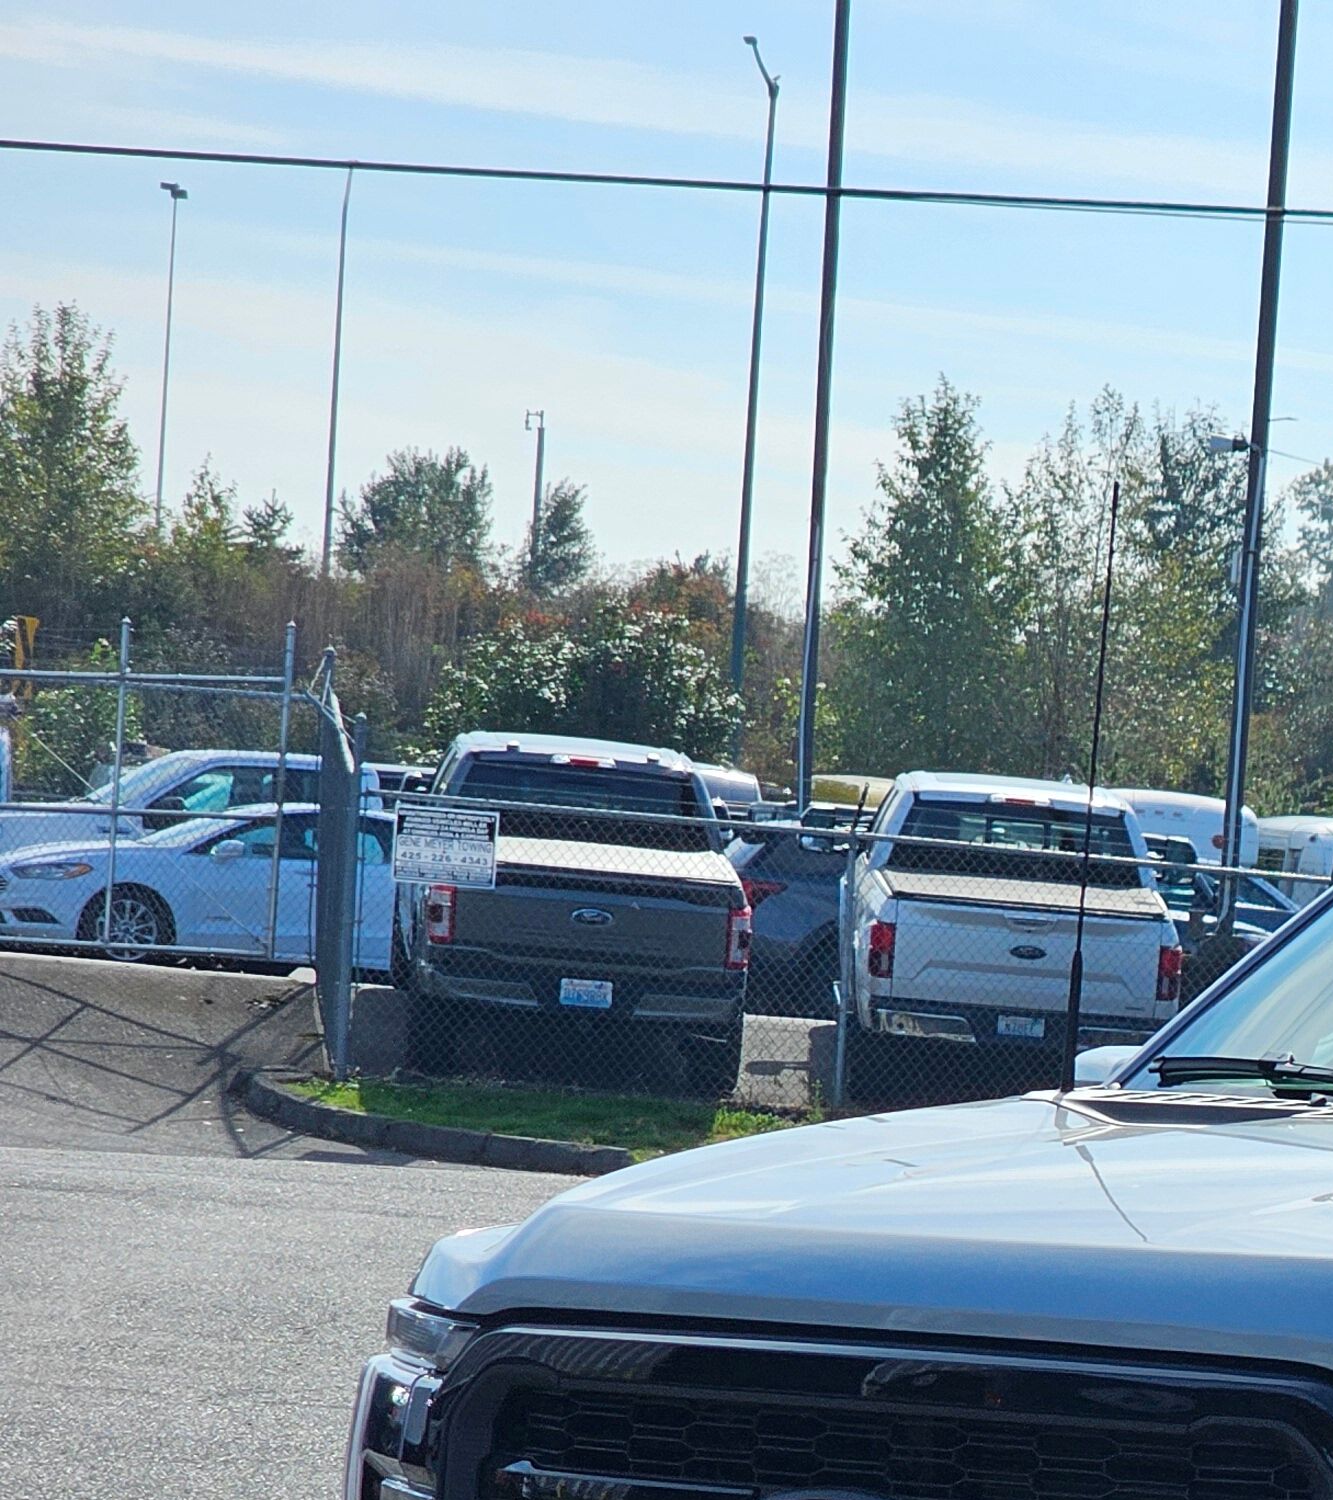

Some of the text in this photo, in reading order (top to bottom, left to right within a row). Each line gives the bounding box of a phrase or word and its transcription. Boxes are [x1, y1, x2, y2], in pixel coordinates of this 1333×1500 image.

[399, 836, 492, 854] GENE MEYER TOWING
